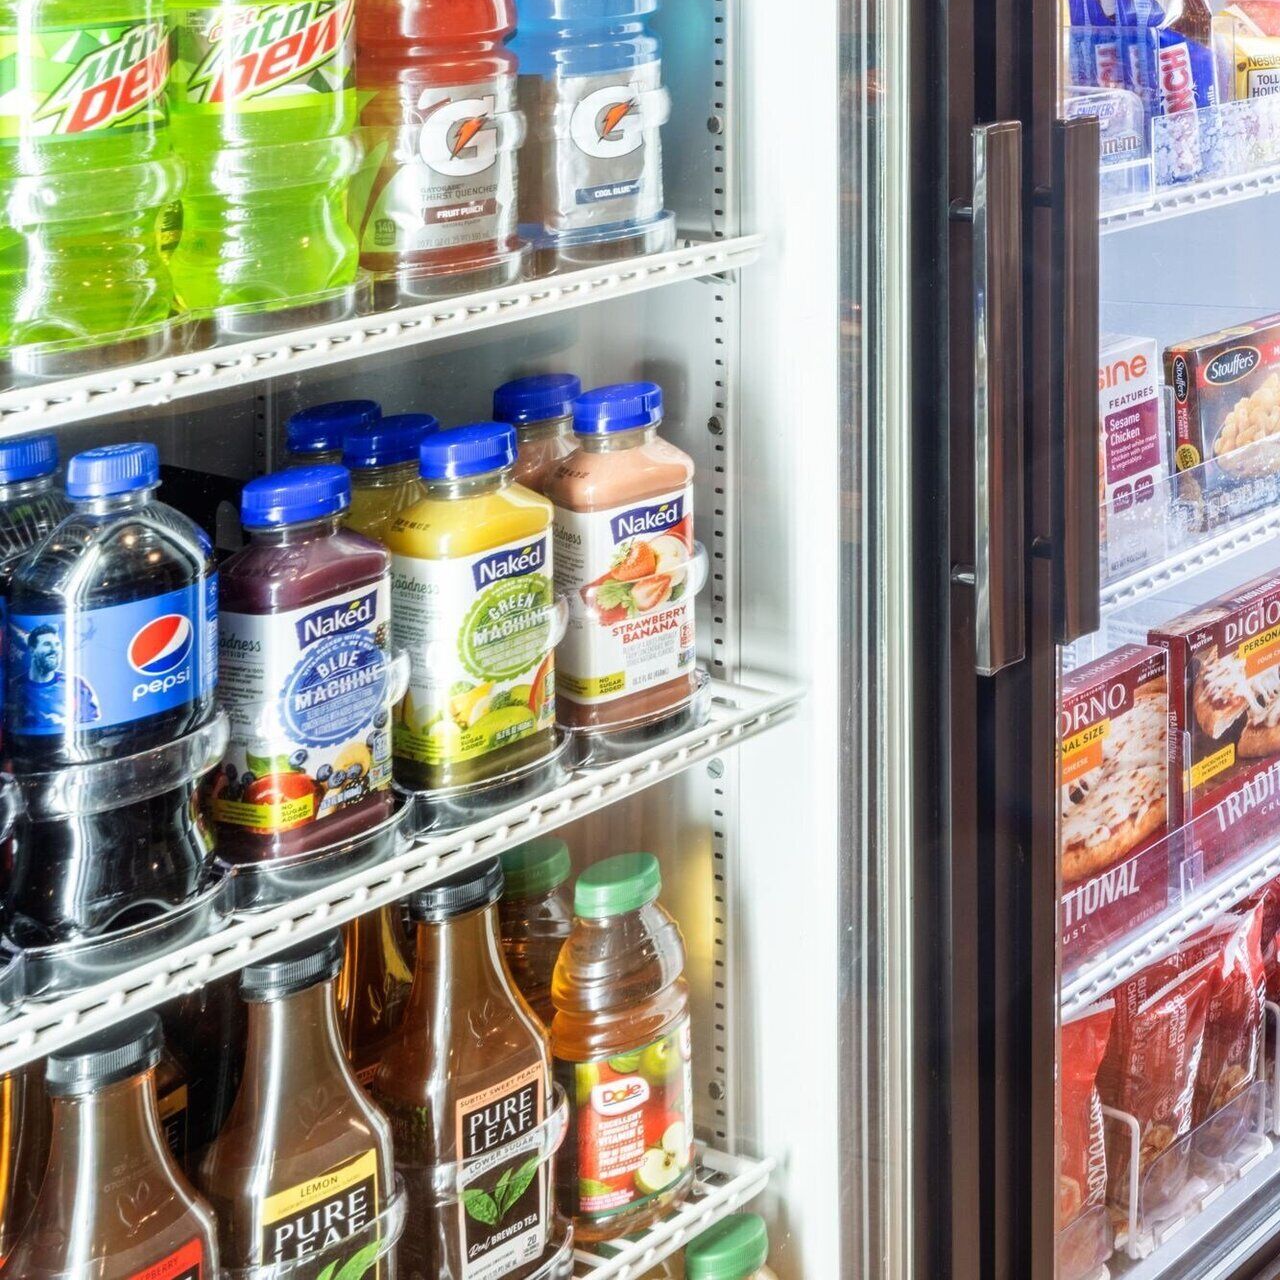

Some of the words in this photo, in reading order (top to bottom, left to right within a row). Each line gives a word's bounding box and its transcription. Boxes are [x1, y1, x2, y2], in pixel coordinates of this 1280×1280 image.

[1258, 74, 1279, 84] TOLL
[419, 95, 498, 177] G
[569, 85, 645, 159] G
[437, 208, 459, 220] FRUIT
[460, 205, 484, 217] PUNCH
[1211, 351, 1255, 380] Stouffer's
[1109, 385, 1154, 410] FEATURES
[1110, 412, 1140, 431] Sesame
[1110, 426, 1140, 446] Chicken
[618, 503, 679, 537] Naked
[480, 545, 541, 583] Naked
[304, 599, 371, 642] Naked
[488, 593, 536, 621] GREEN
[612, 604, 687, 637] STRAWBERRY
[623, 620, 679, 644] BANANA
[1190, 635, 1213, 651] PROTEIN
[317, 649, 361, 679] BLUE
[1257, 654, 1273, 665] FOUR
[132, 667, 190, 702] pepsi
[599, 678, 622, 689] SUGAR
[1083, 724, 1105, 744] SIZE
[460, 1091, 487, 1108] SUBTLY
[489, 1079, 516, 1098] SWEET
[517, 1064, 542, 1083] PEACH
[602, 1083, 641, 1104] Dole
[470, 1087, 533, 1136] PURE
[470, 1107, 533, 1155] LEAF
[469, 1149, 502, 1174] LOWER
[503, 1136, 534, 1156] SUGAR
[300, 1176, 338, 1198] LEMON
[275, 1187, 367, 1252] PURE
[468, 1236, 491, 1258] Real
[491, 1220, 524, 1245] BREWED
[524, 1213, 538, 1229] TEA
